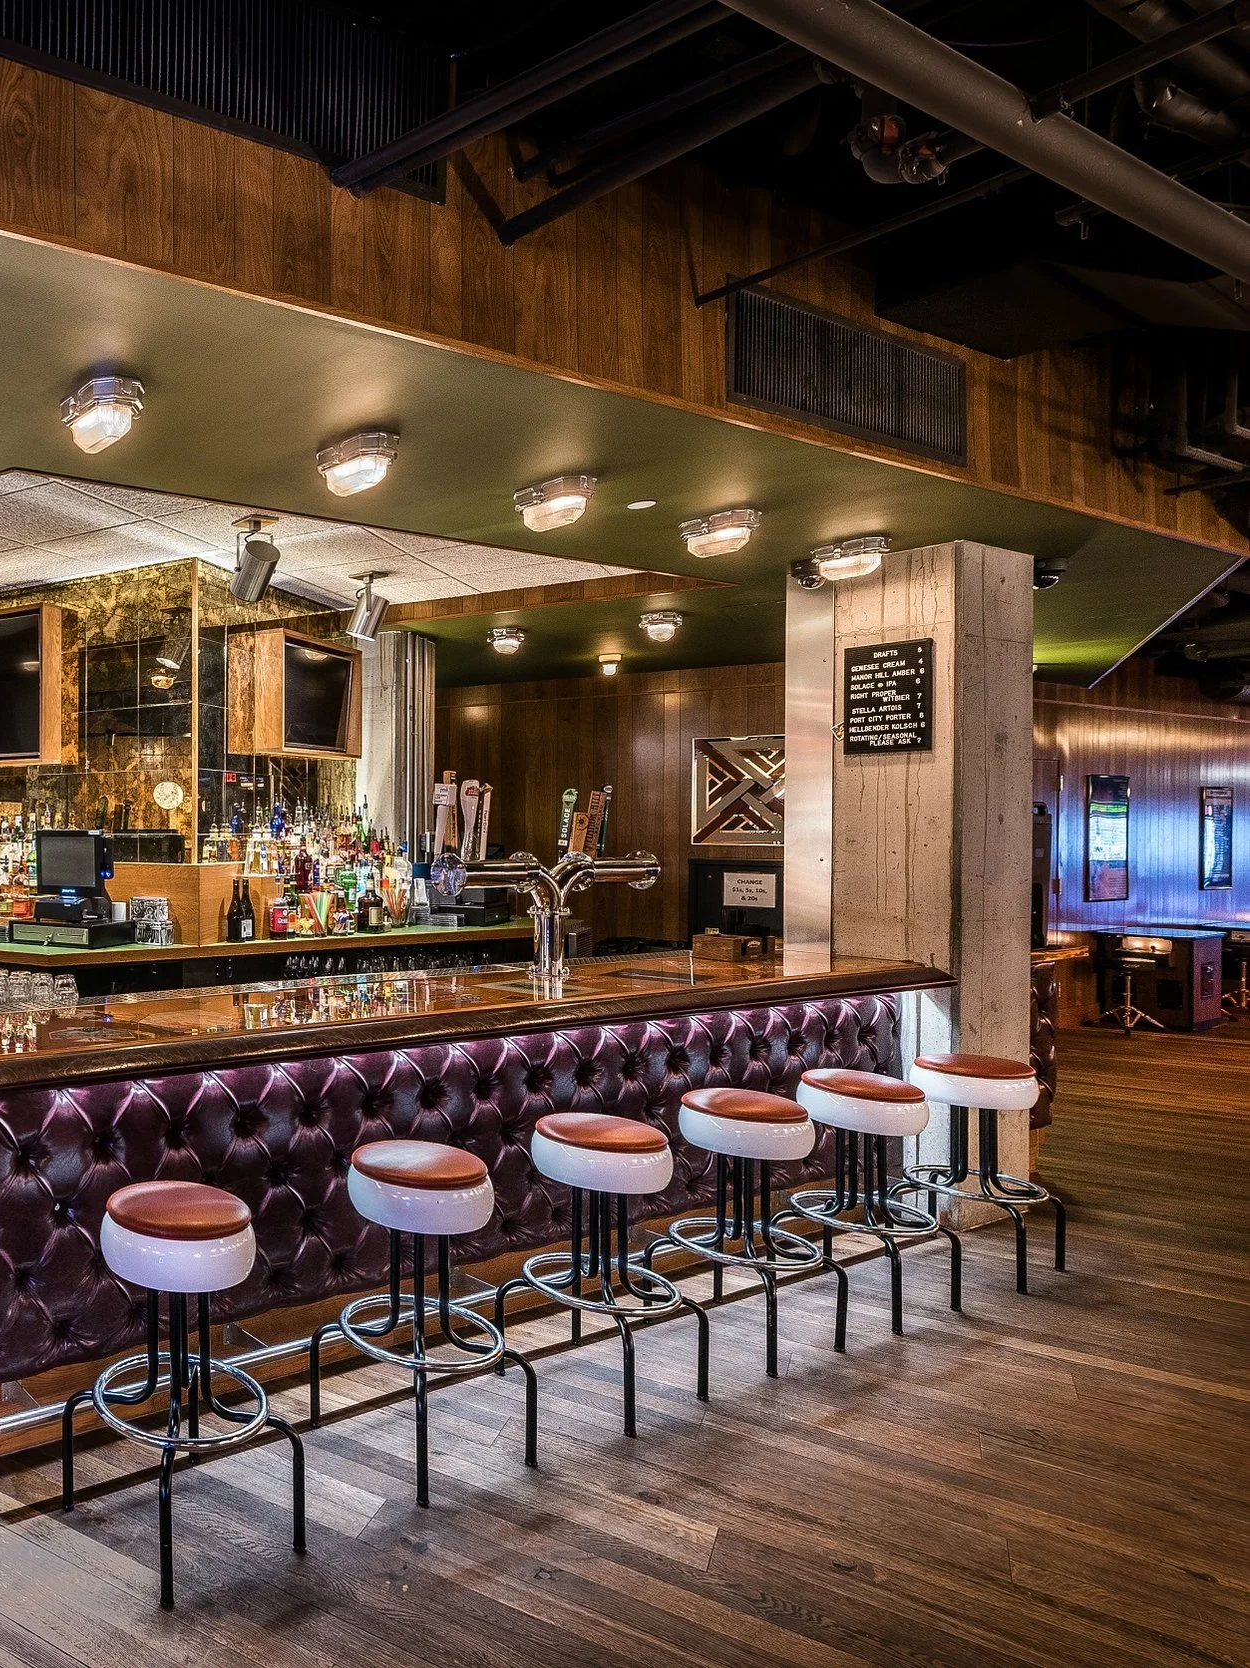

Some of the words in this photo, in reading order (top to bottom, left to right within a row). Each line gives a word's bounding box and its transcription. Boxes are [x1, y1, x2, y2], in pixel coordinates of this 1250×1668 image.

[874, 650, 898, 658] DRAFTS
[851, 663, 880, 672] GENESEE
[883, 660, 905, 668] CREAM
[892, 669, 915, 677] AMBER
[851, 682, 875, 690] SOLACE
[849, 724, 889, 733] HELLBENDER
[850, 732, 917, 742] ROTATING/SEASONAL
[561, 808, 570, 838] SOLACE
